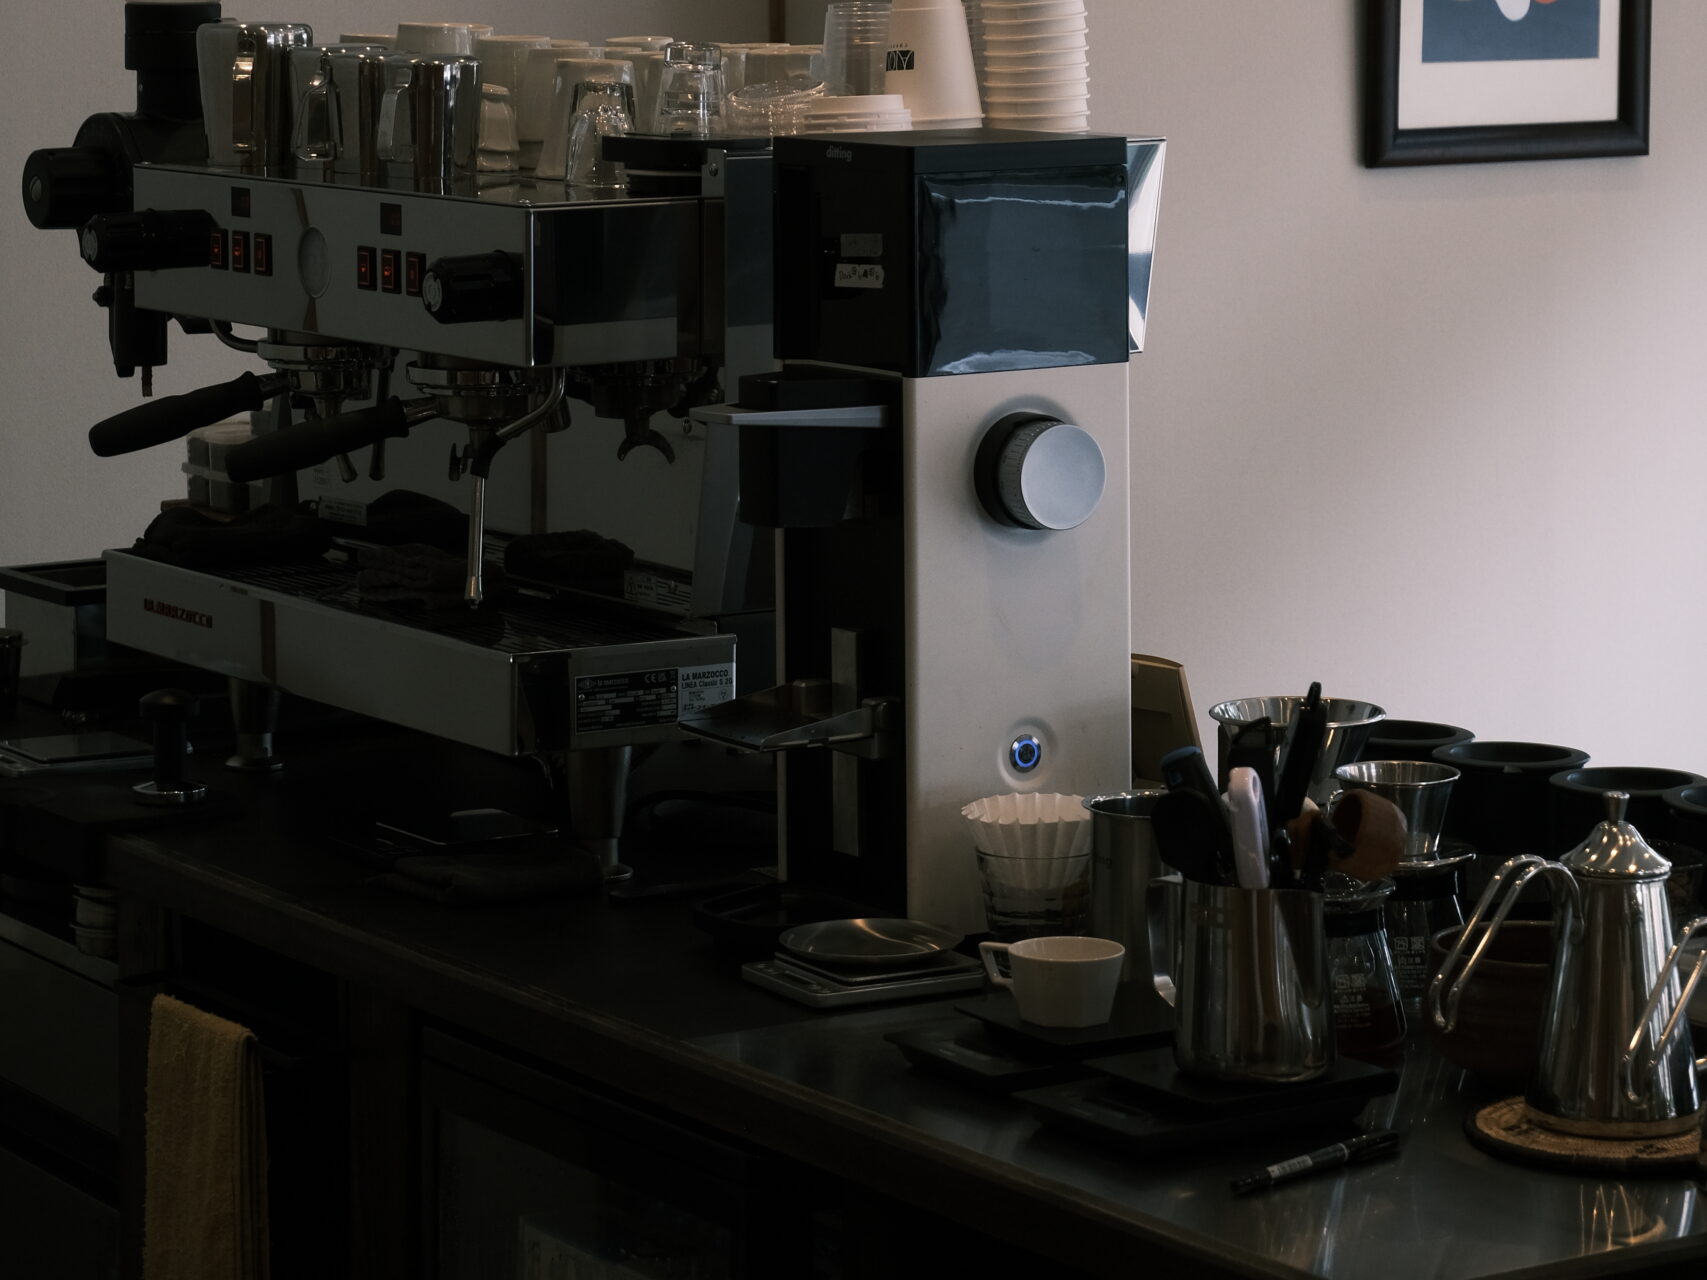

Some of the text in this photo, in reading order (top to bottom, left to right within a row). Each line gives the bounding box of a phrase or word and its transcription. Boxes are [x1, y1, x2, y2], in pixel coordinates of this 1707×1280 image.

[681, 669, 729, 681] LA MARZOCCO
[681, 681, 697, 689] LINEA
